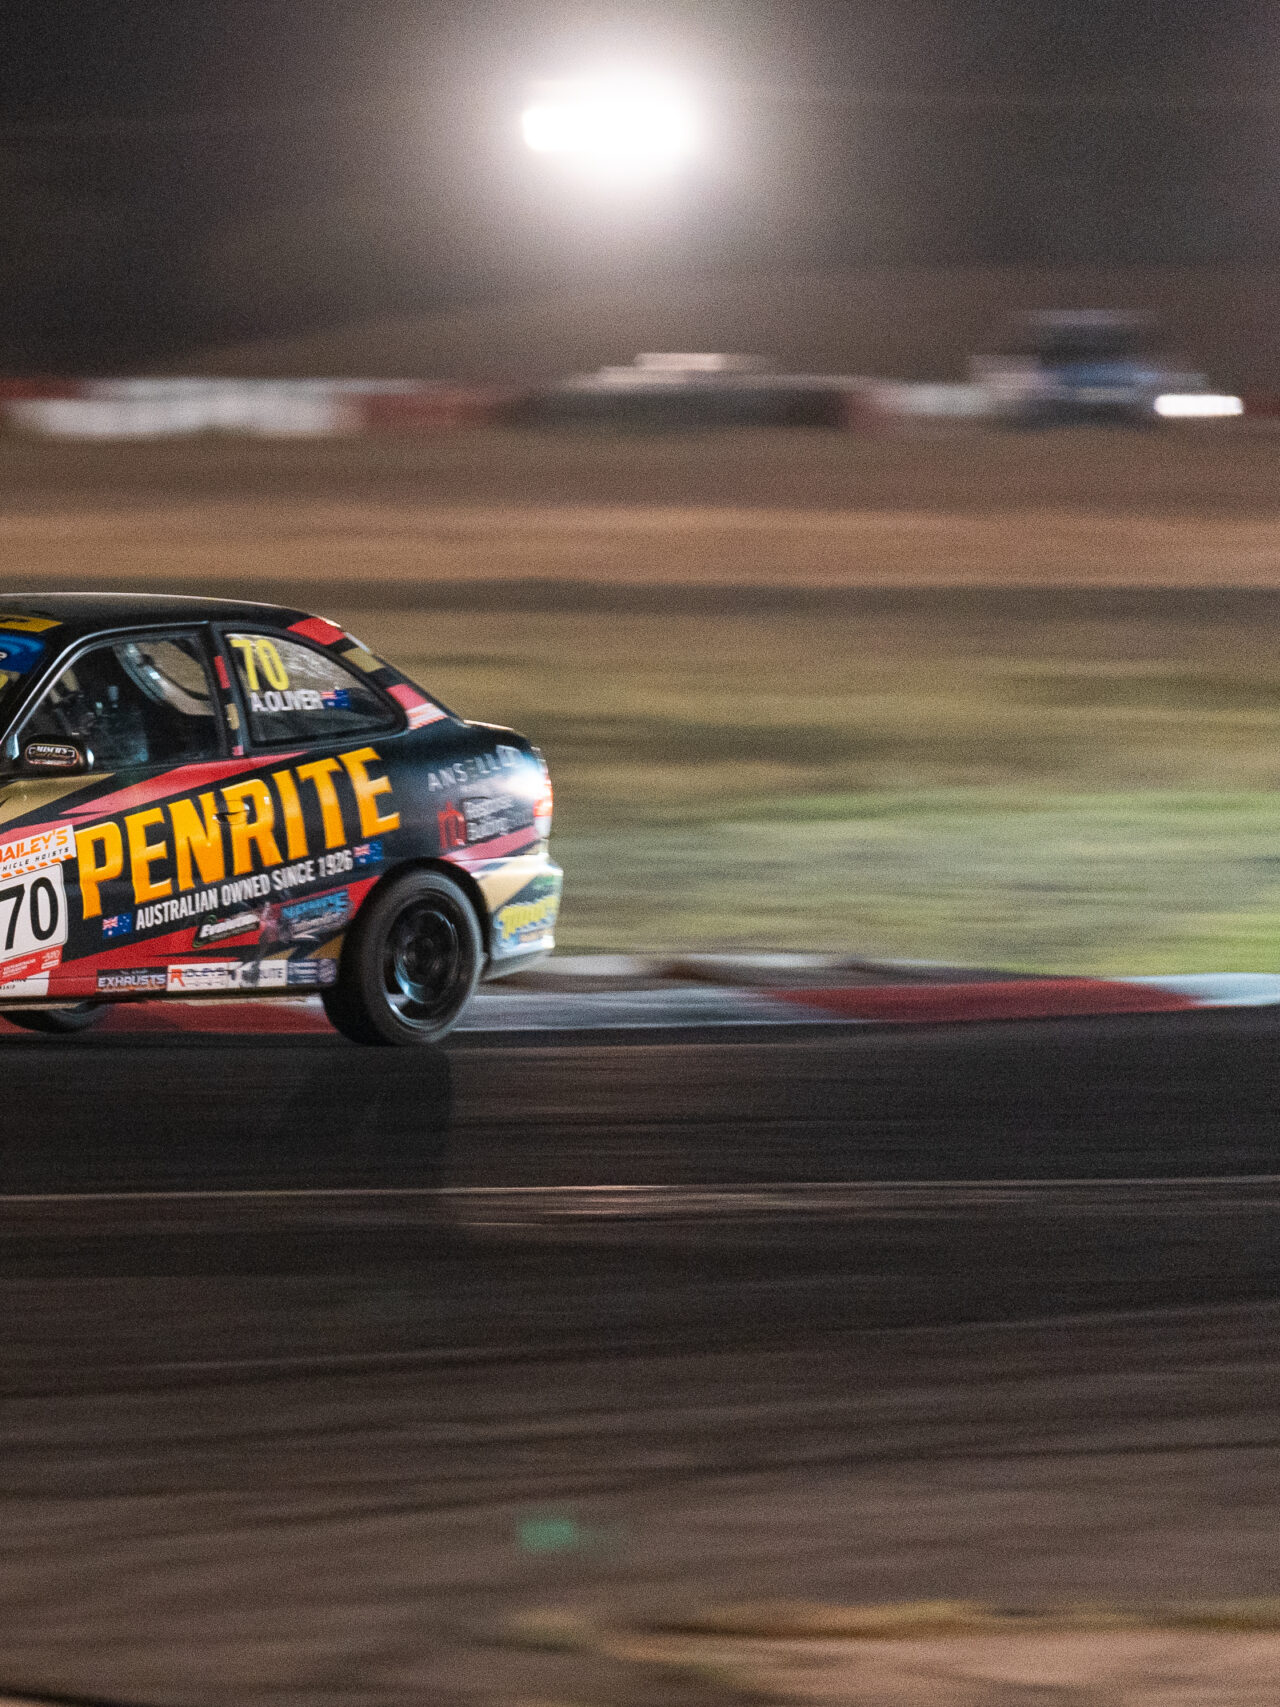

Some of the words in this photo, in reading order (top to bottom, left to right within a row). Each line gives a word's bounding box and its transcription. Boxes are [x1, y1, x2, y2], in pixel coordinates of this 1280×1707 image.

[230, 639, 289, 691] 70
[35, 847, 70, 861] HOISTS
[74, 747, 401, 920] PENRITE
[136, 888, 218, 930] AUSTRALIAN
[221, 874, 270, 906] OWNED
[272, 860, 316, 891] SINCE
[318, 850, 354, 877] 1926
[98, 974, 166, 988] EXHAUSTS
